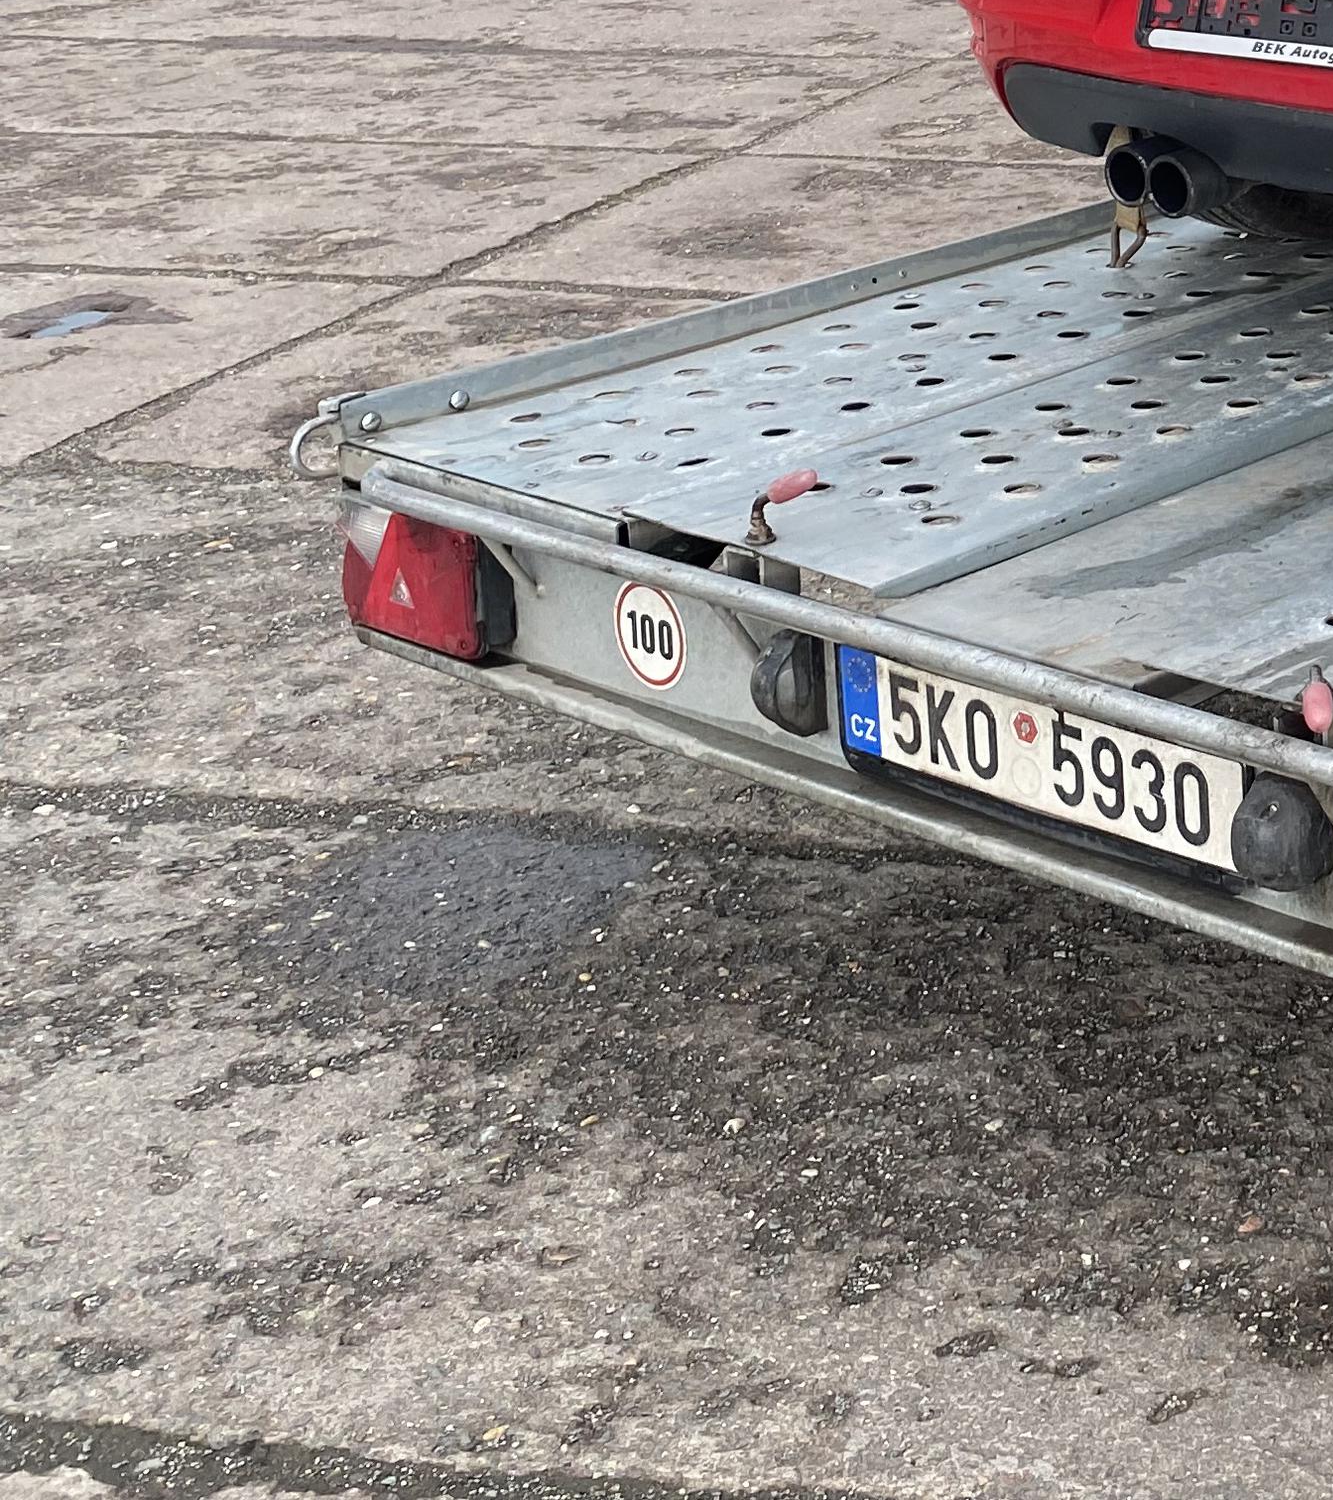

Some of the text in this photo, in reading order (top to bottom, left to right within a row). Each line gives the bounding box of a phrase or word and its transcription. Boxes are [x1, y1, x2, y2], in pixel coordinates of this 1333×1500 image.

[1251, 40, 1286, 56] BEK
[626, 609, 675, 662] 100
[851, 713, 878, 742] CZ
[1050, 707, 1211, 847] 5930
